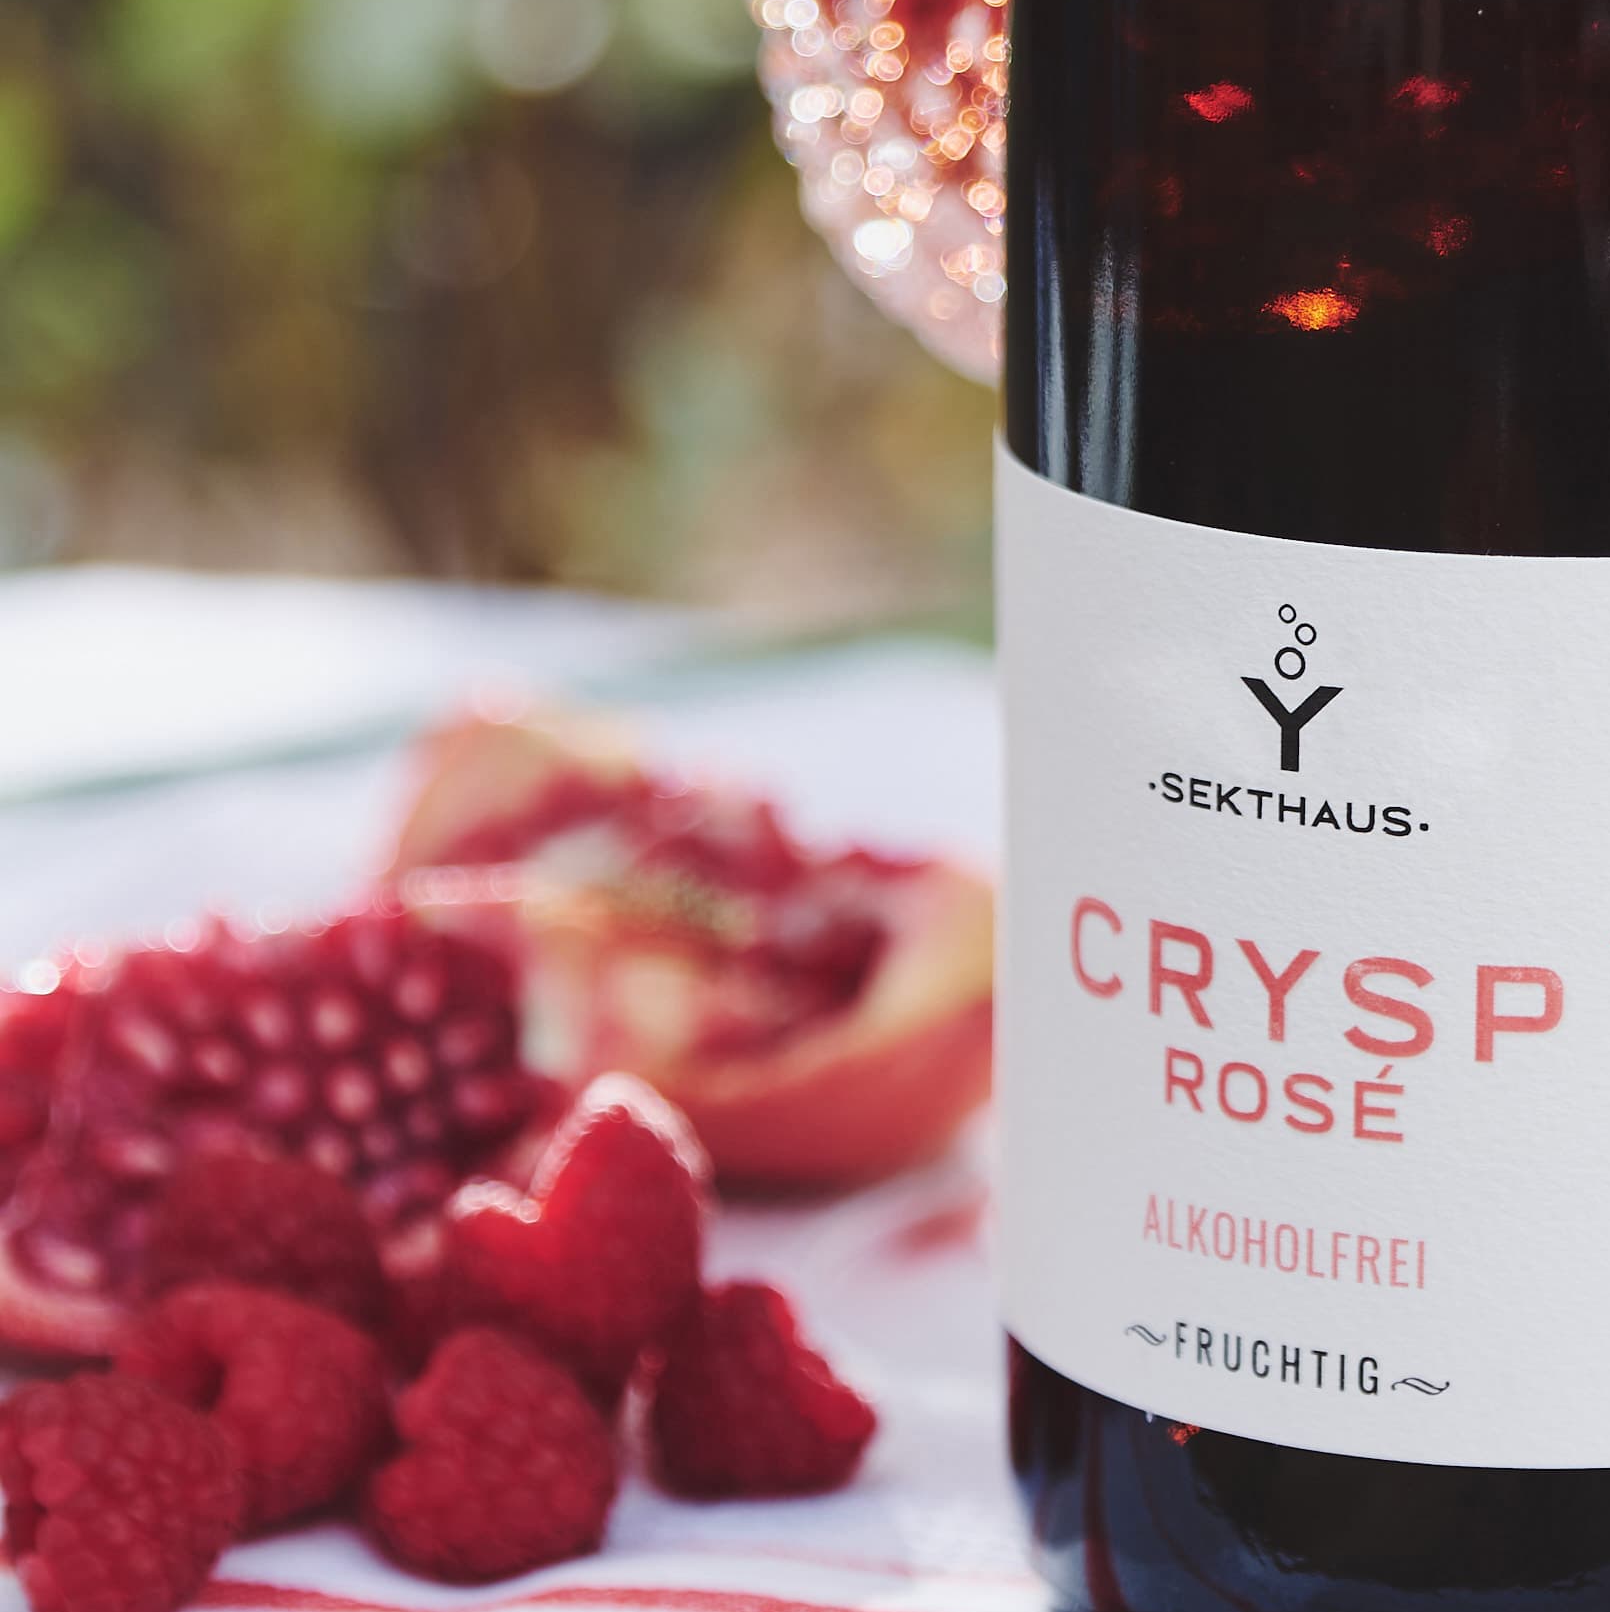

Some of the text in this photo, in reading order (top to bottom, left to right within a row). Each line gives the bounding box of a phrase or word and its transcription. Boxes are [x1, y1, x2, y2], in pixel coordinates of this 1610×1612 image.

[1239, 676, 1345, 773] Y
[1069, 895, 1566, 1065] CRYSP
[1164, 1045, 1405, 1144] ROSÉ
[1143, 1192, 1427, 1289] ALKOHOLFREI
